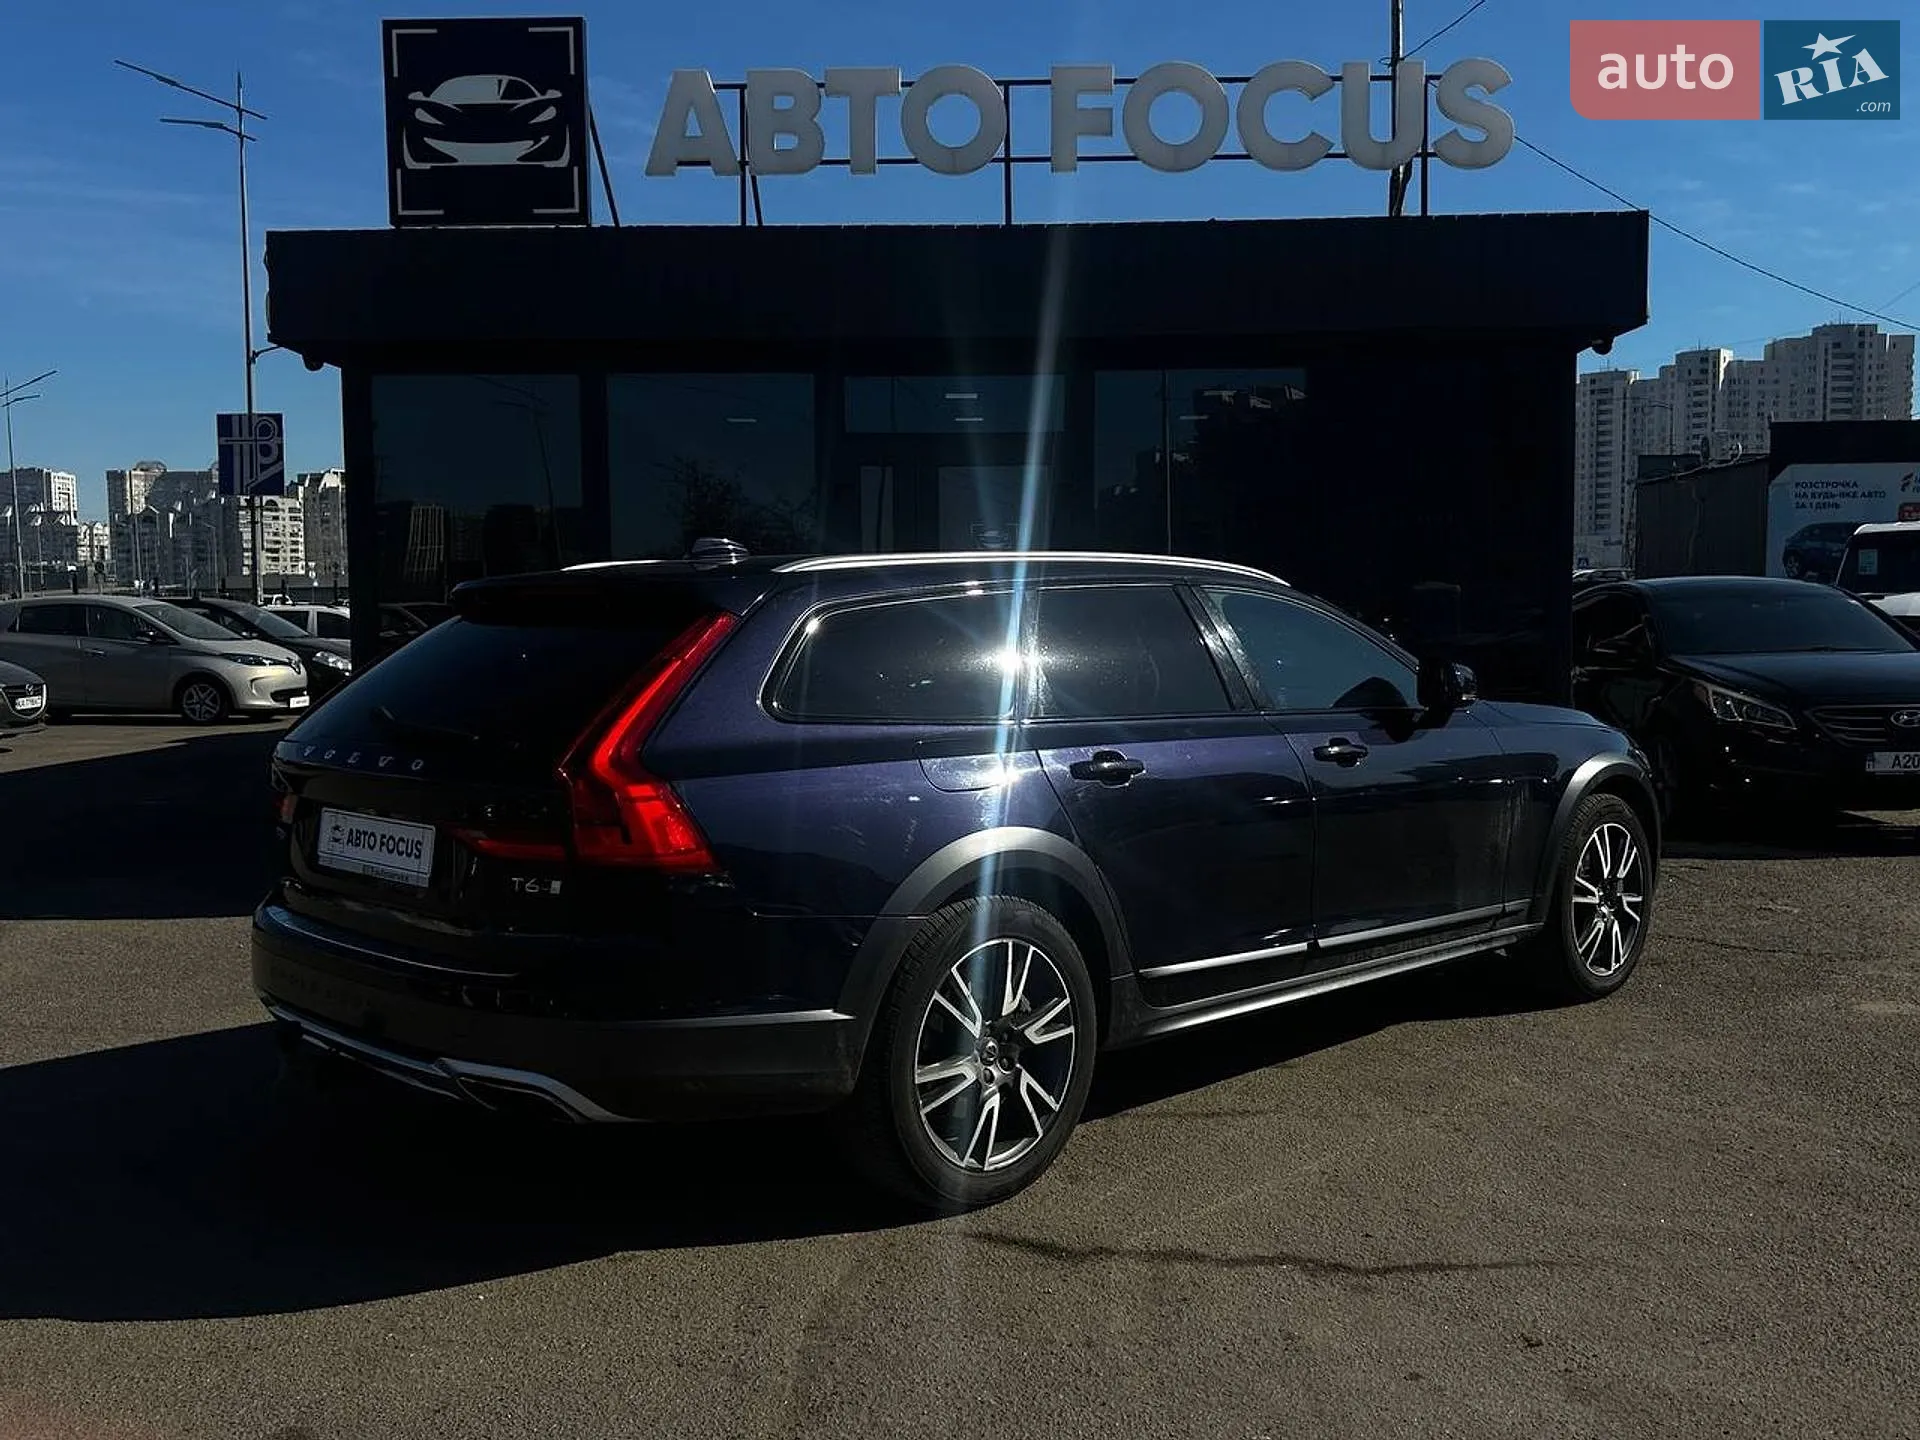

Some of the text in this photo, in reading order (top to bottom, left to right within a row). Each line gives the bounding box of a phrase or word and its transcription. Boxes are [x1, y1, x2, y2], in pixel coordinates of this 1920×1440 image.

[645, 59, 1515, 177] АВТО FOCUS
[302, 744, 425, 771] VOLVO
[346, 828, 423, 859] АВТО FOCUS
[511, 877, 540, 893] T6
